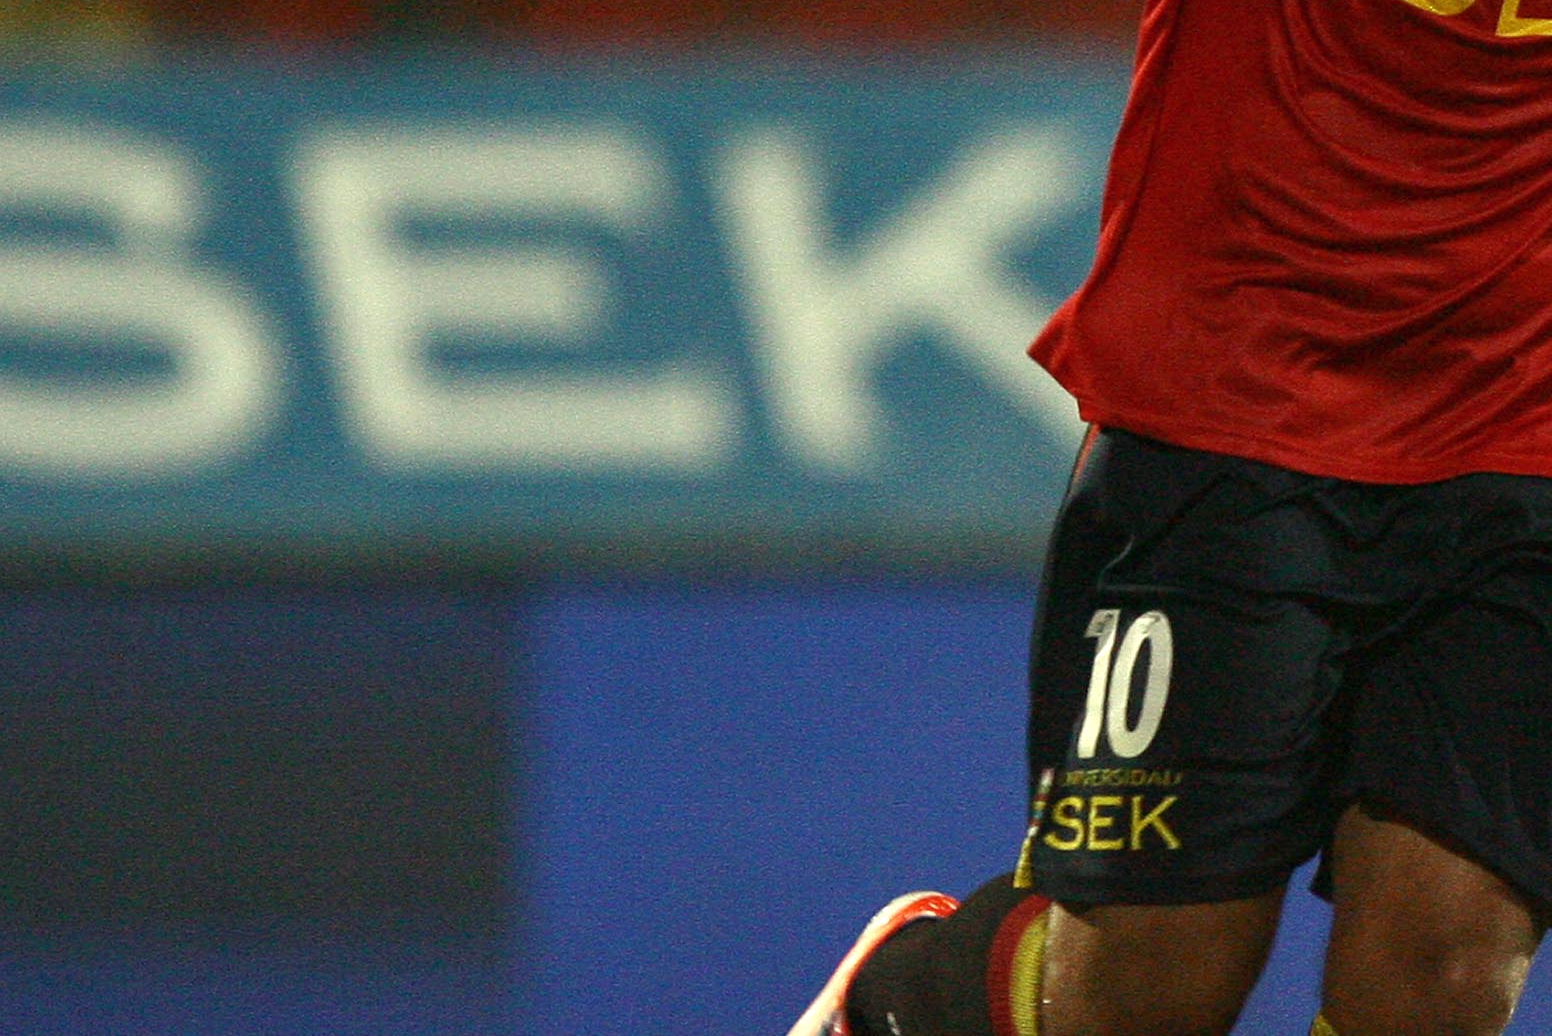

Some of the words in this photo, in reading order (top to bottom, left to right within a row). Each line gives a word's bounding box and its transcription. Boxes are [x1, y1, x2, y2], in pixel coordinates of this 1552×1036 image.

[0, 126, 1088, 476] SEK
[1077, 609, 1174, 759] 10
[1044, 795, 1182, 851] SEK
